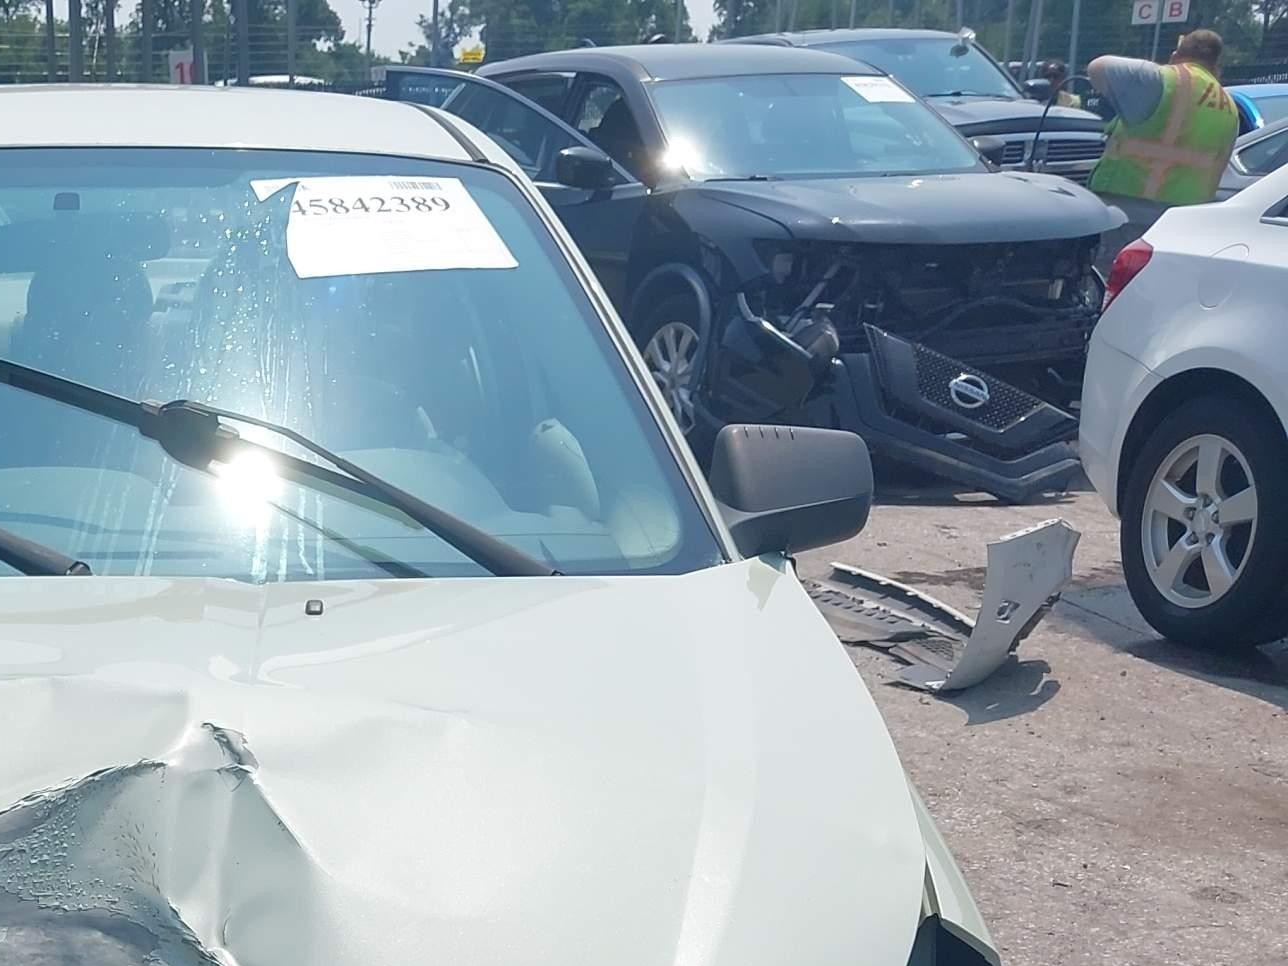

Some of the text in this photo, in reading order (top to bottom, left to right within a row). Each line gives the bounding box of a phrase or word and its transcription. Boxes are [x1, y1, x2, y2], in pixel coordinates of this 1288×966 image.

[1138, 4, 1153, 19] C
[1169, 1, 1183, 17] B
[292, 196, 451, 217] 45842389
